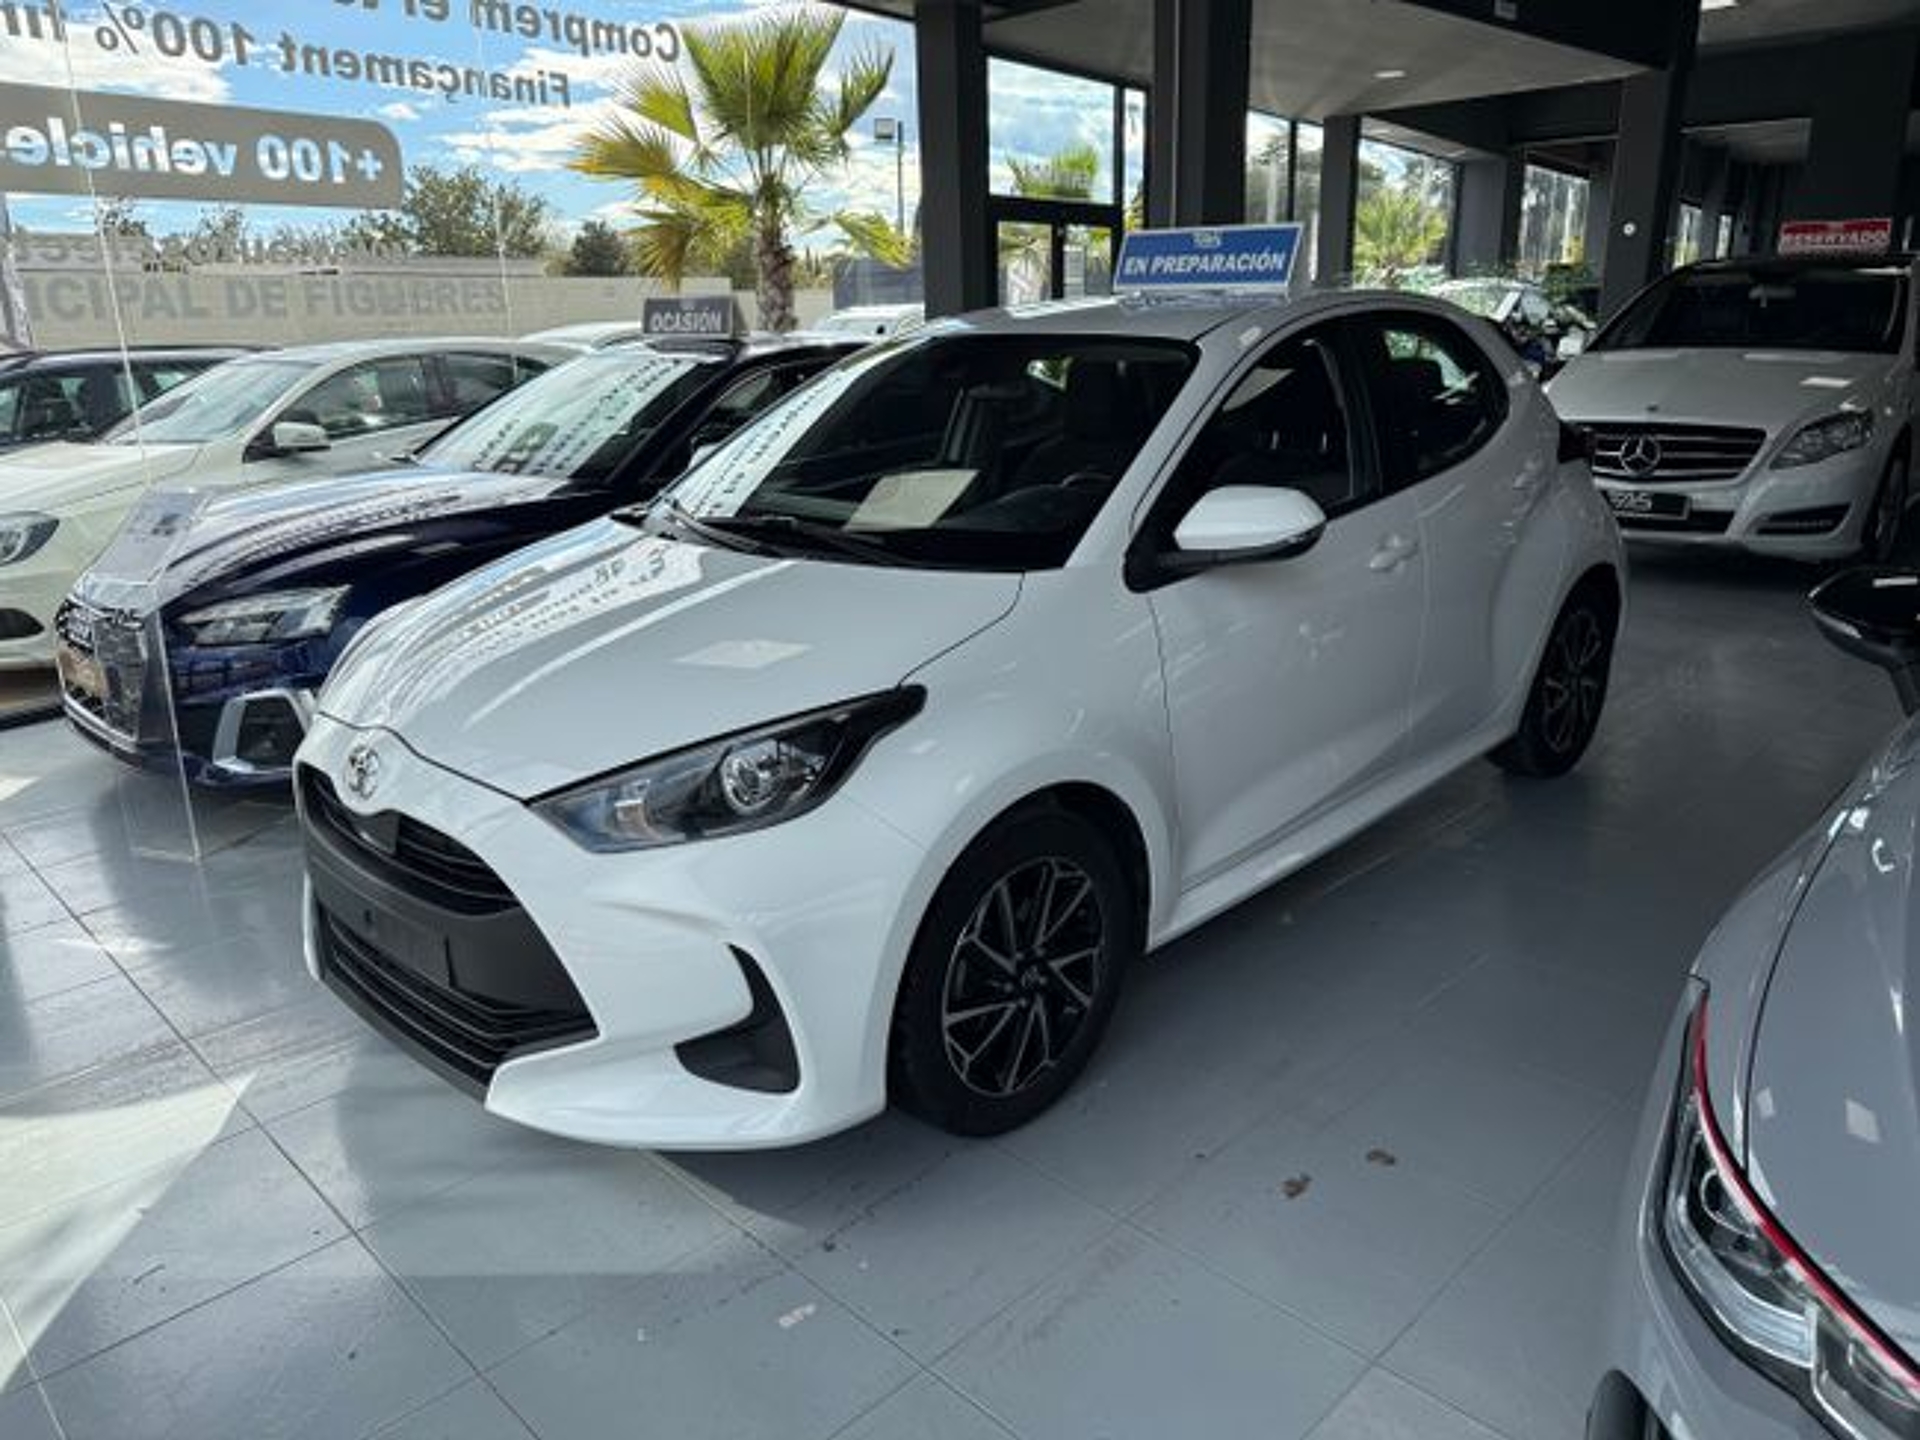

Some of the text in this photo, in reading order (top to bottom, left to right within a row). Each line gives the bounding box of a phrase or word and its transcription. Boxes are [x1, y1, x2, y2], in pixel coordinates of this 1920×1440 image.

[1124, 247, 1285, 275] EN PREPARACIÓN
[226, 276, 286, 318] DE
[650, 306, 722, 332] OCASIÓN
